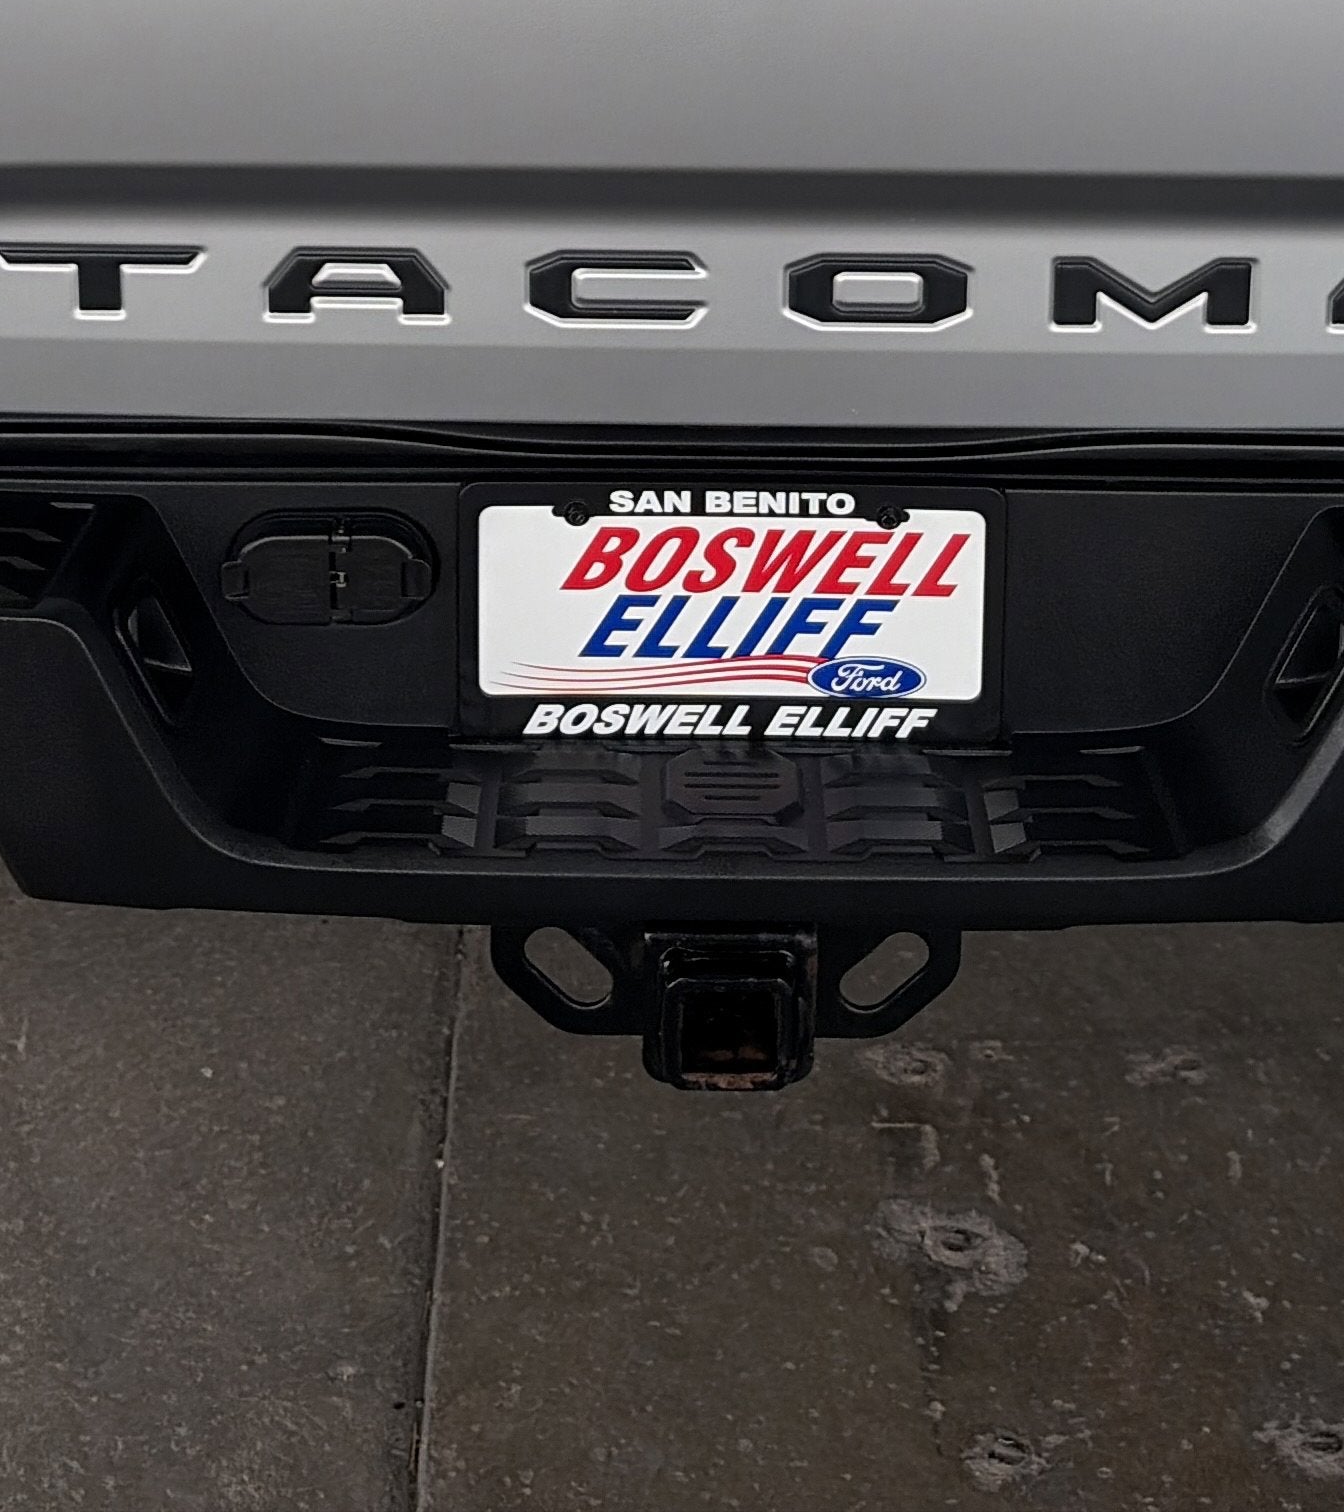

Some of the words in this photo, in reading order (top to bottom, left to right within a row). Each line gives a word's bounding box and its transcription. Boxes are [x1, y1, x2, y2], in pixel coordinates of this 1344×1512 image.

[609, 490, 692, 515] SAN
[705, 491, 855, 516] BENITO
[559, 526, 971, 597] BOSWELL
[578, 595, 900, 659] ELLIFF
[830, 663, 904, 694] Ford
[523, 703, 752, 737] BOSWELL
[763, 705, 938, 739] ELLIFF
